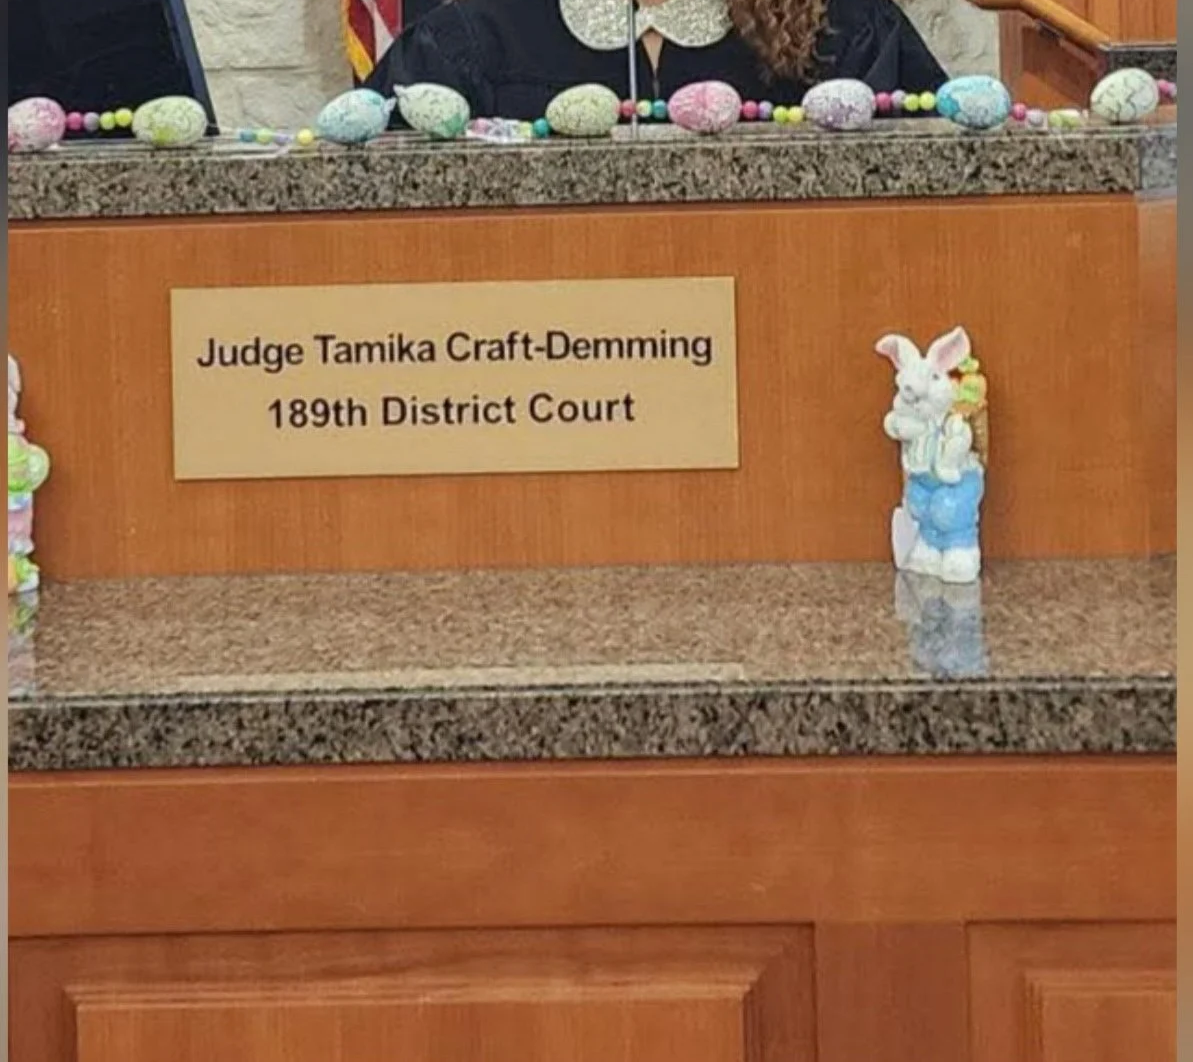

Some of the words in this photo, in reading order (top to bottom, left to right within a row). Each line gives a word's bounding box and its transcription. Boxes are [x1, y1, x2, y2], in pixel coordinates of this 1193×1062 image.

[197, 337, 304, 373] Judge
[314, 334, 435, 364] Tamika
[447, 330, 712, 366] Craft-Demming
[269, 398, 366, 428] 189th
[382, 395, 516, 426] District
[530, 393, 634, 422] Court
